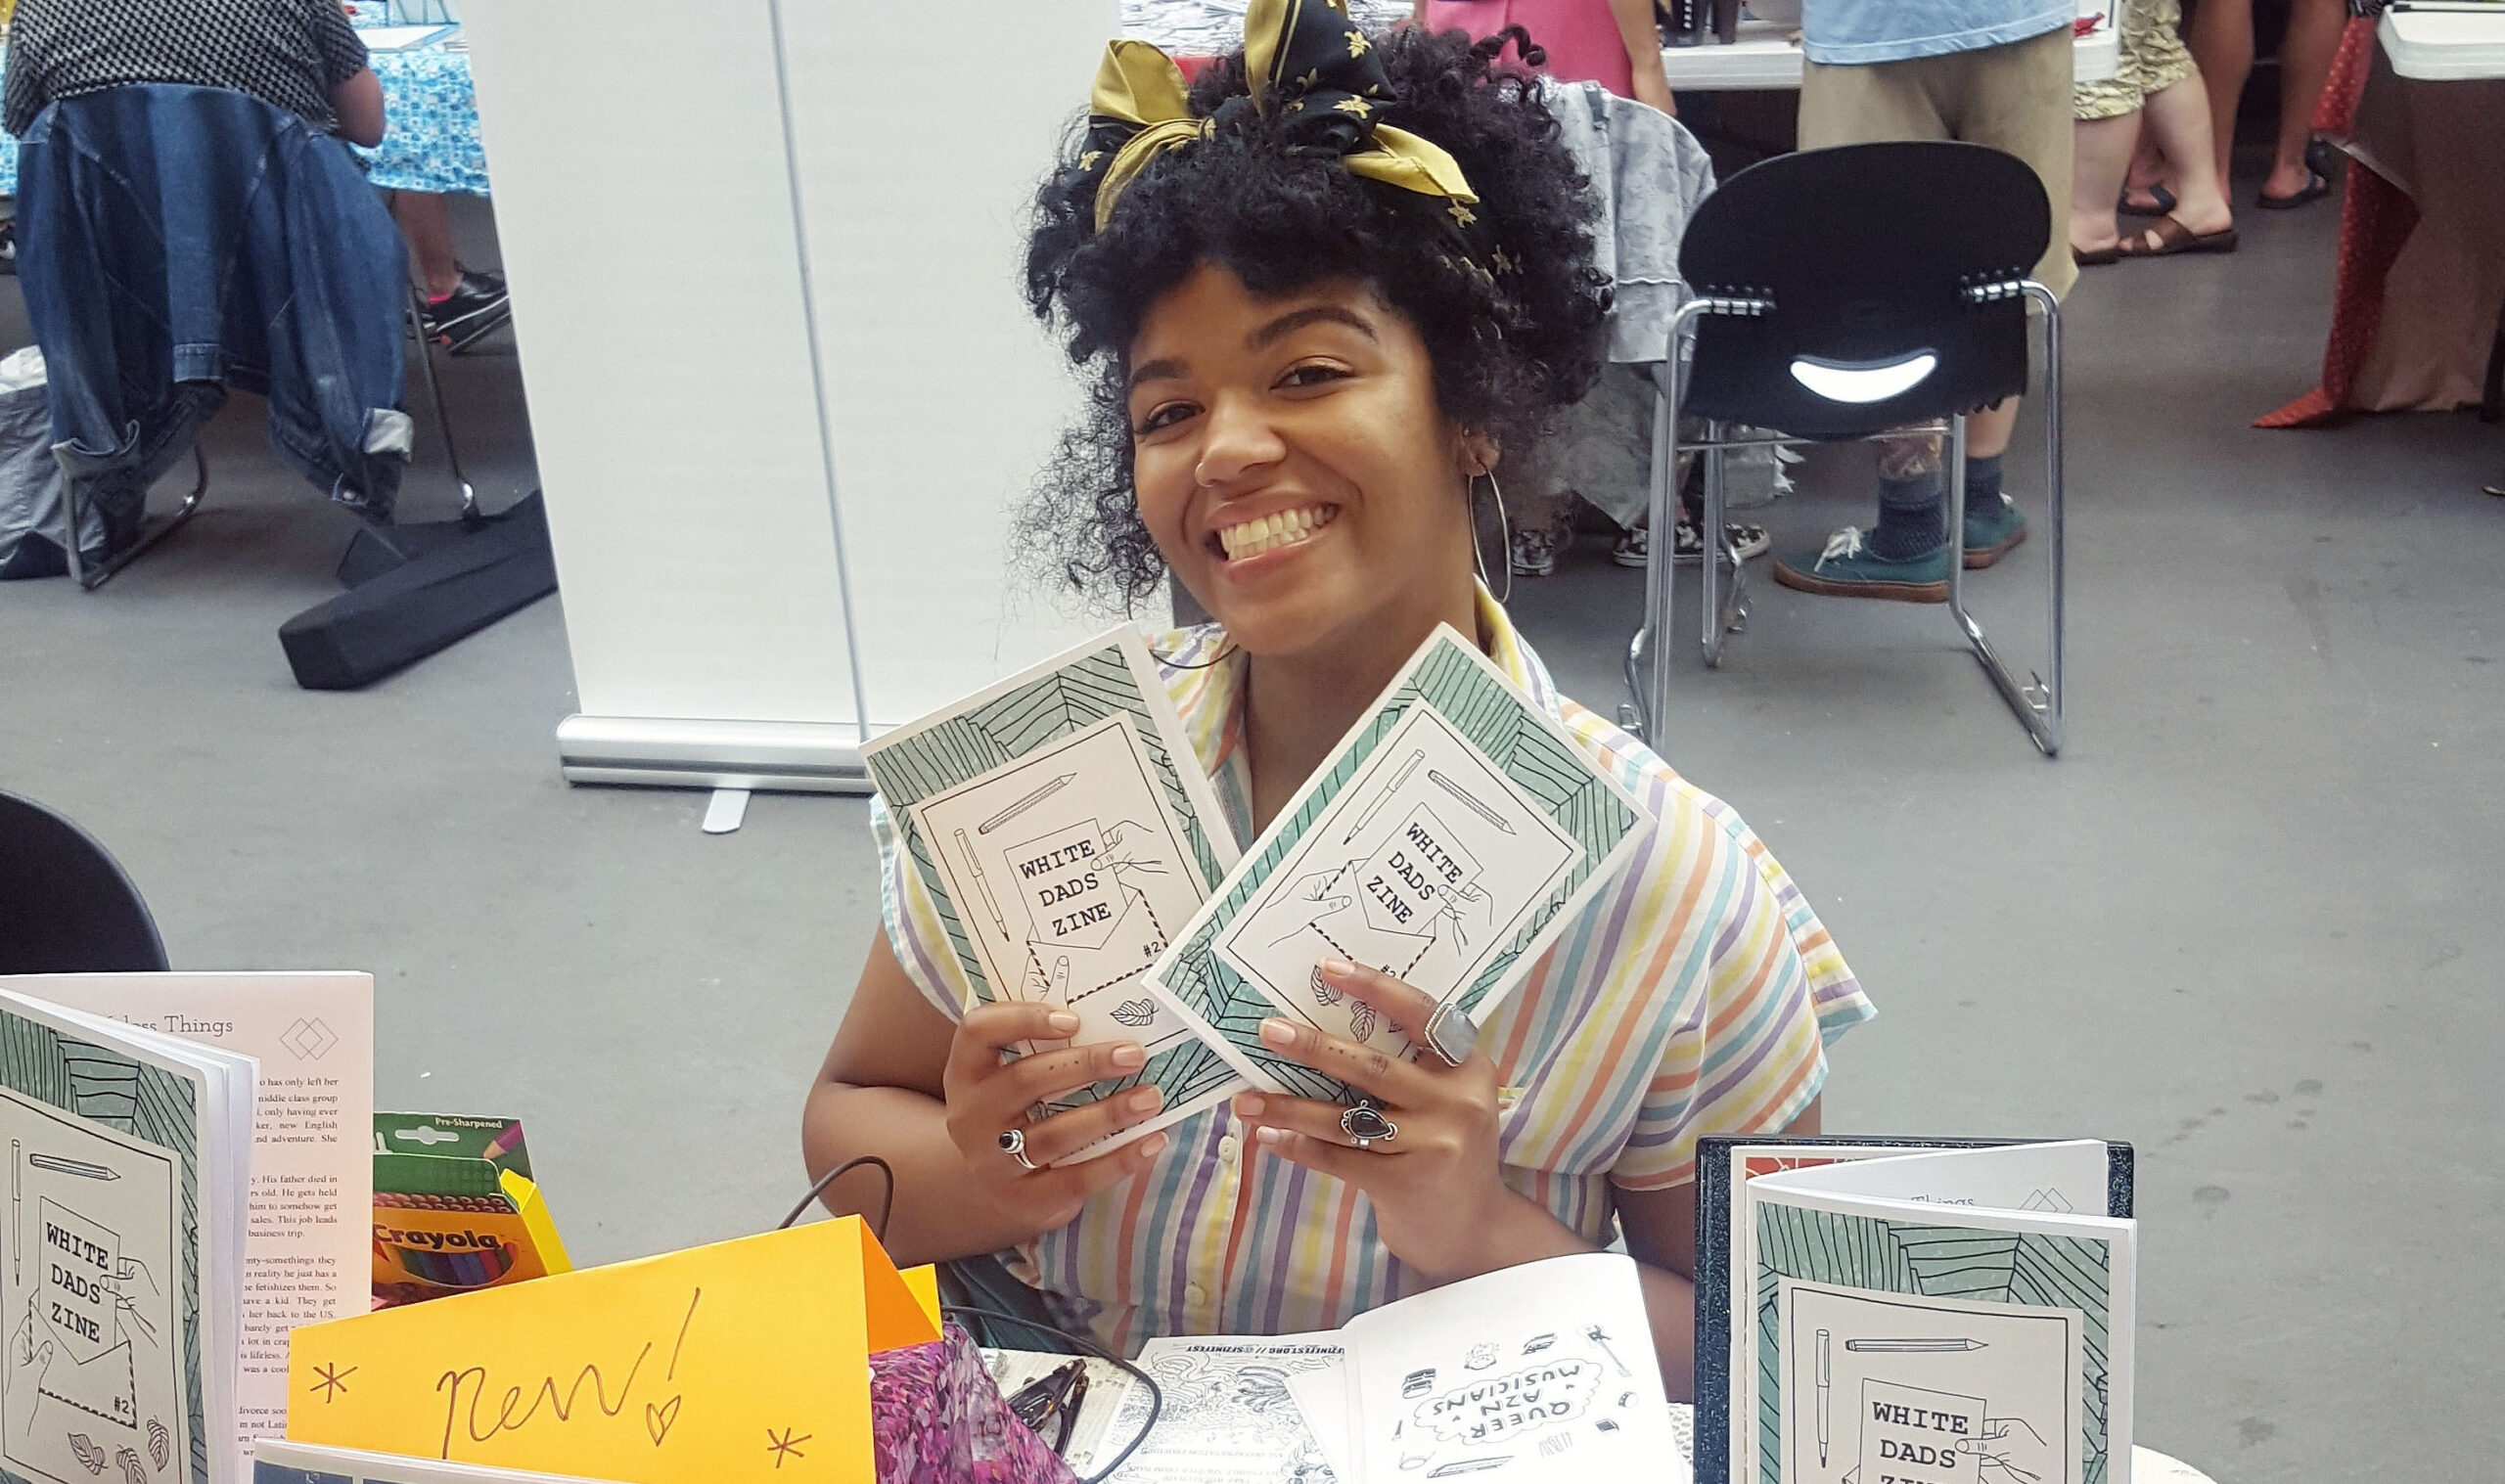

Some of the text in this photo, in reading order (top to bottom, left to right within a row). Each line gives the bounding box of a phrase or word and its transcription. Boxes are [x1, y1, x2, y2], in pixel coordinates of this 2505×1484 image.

[1019, 839, 1096, 879] WHITE
[1406, 822, 1464, 884] WHITE
[1388, 851, 1435, 901] DADS
[1038, 873, 1099, 907] DADS
[1366, 875, 1414, 924] ZINE
[1052, 902, 1113, 937] ZINE
[1143, 941, 1161, 958] #2
[163, 1014, 234, 1038] Things
[285, 1078, 304, 1088] only
[264, 1108, 284, 1117] only
[287, 1108, 316, 1117] having
[434, 1117, 503, 1129] Pre-Sharpened
[305, 1121, 338, 1131] English
[297, 1190, 315, 1198] gets
[278, 1215, 296, 1224] This
[298, 1215, 312, 1225] job
[316, 1215, 338, 1224] leads
[324, 1203, 338, 1212] get
[46, 1221, 109, 1271] WHITE
[373, 1223, 502, 1250] Crayola
[318, 1256, 336, 1266] they
[51, 1263, 100, 1304] DADS
[254, 1270, 281, 1280] reality
[296, 1270, 312, 1280] just
[255, 1282, 296, 1291] fetishizes
[325, 1282, 336, 1291] So
[297, 1296, 316, 1306] They
[323, 1298, 336, 1307] get
[51, 1301, 100, 1344] ZINE
[245, 1324, 271, 1333] barely
[1433, 1365, 1580, 1416] MUSICIANS
[1480, 1388, 1541, 1416] AZN
[114, 1395, 129, 1415] #2
[1471, 1401, 1571, 1439] QUEER
[1872, 1401, 1969, 1435] WHITE
[1880, 1439, 1956, 1469] DADS
